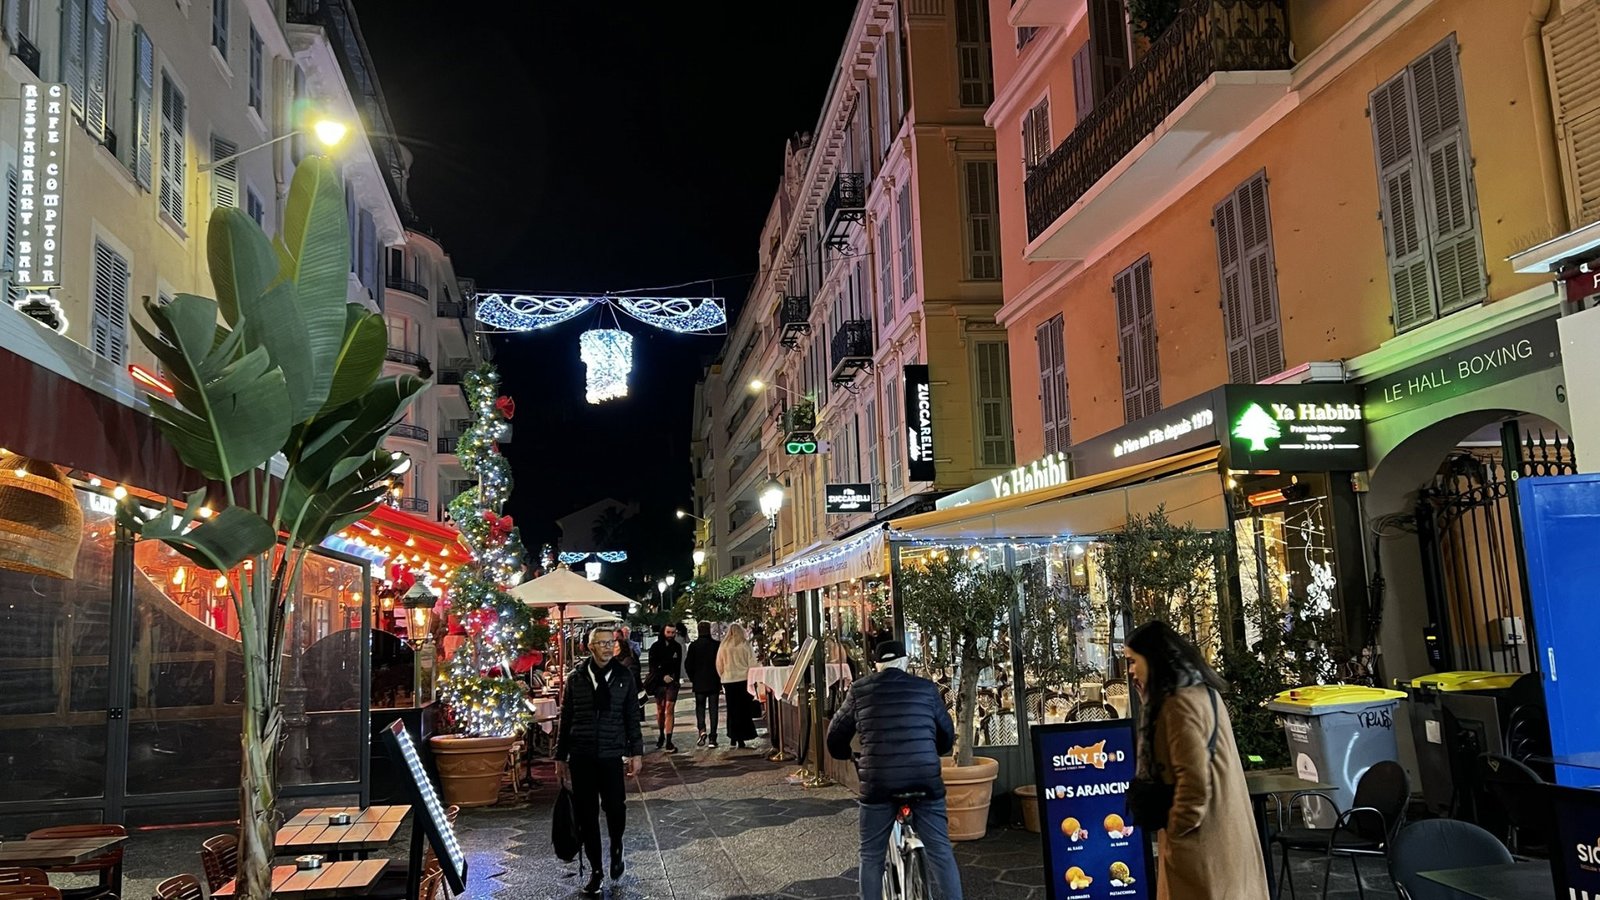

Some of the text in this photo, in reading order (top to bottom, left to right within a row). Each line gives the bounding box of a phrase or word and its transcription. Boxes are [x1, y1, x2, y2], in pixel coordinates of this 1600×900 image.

[42, 86, 61, 282] CAFE COMPTOIR
[18, 241, 31, 282] BAR
[1384, 339, 1533, 404] LE HALL BOXING
[1271, 403, 1362, 420] Ya Habibi
[1555, 385, 1566, 404] 6
[917, 383, 933, 462] ZUCCARELLI
[1149, 428, 1165, 445] Fils
[1163, 418, 1192, 441] depuis
[990, 451, 1068, 499] Ya Habibi
[828, 494, 871, 503] ZUCCARELLI
[1052, 752, 1088, 767] SICILY
